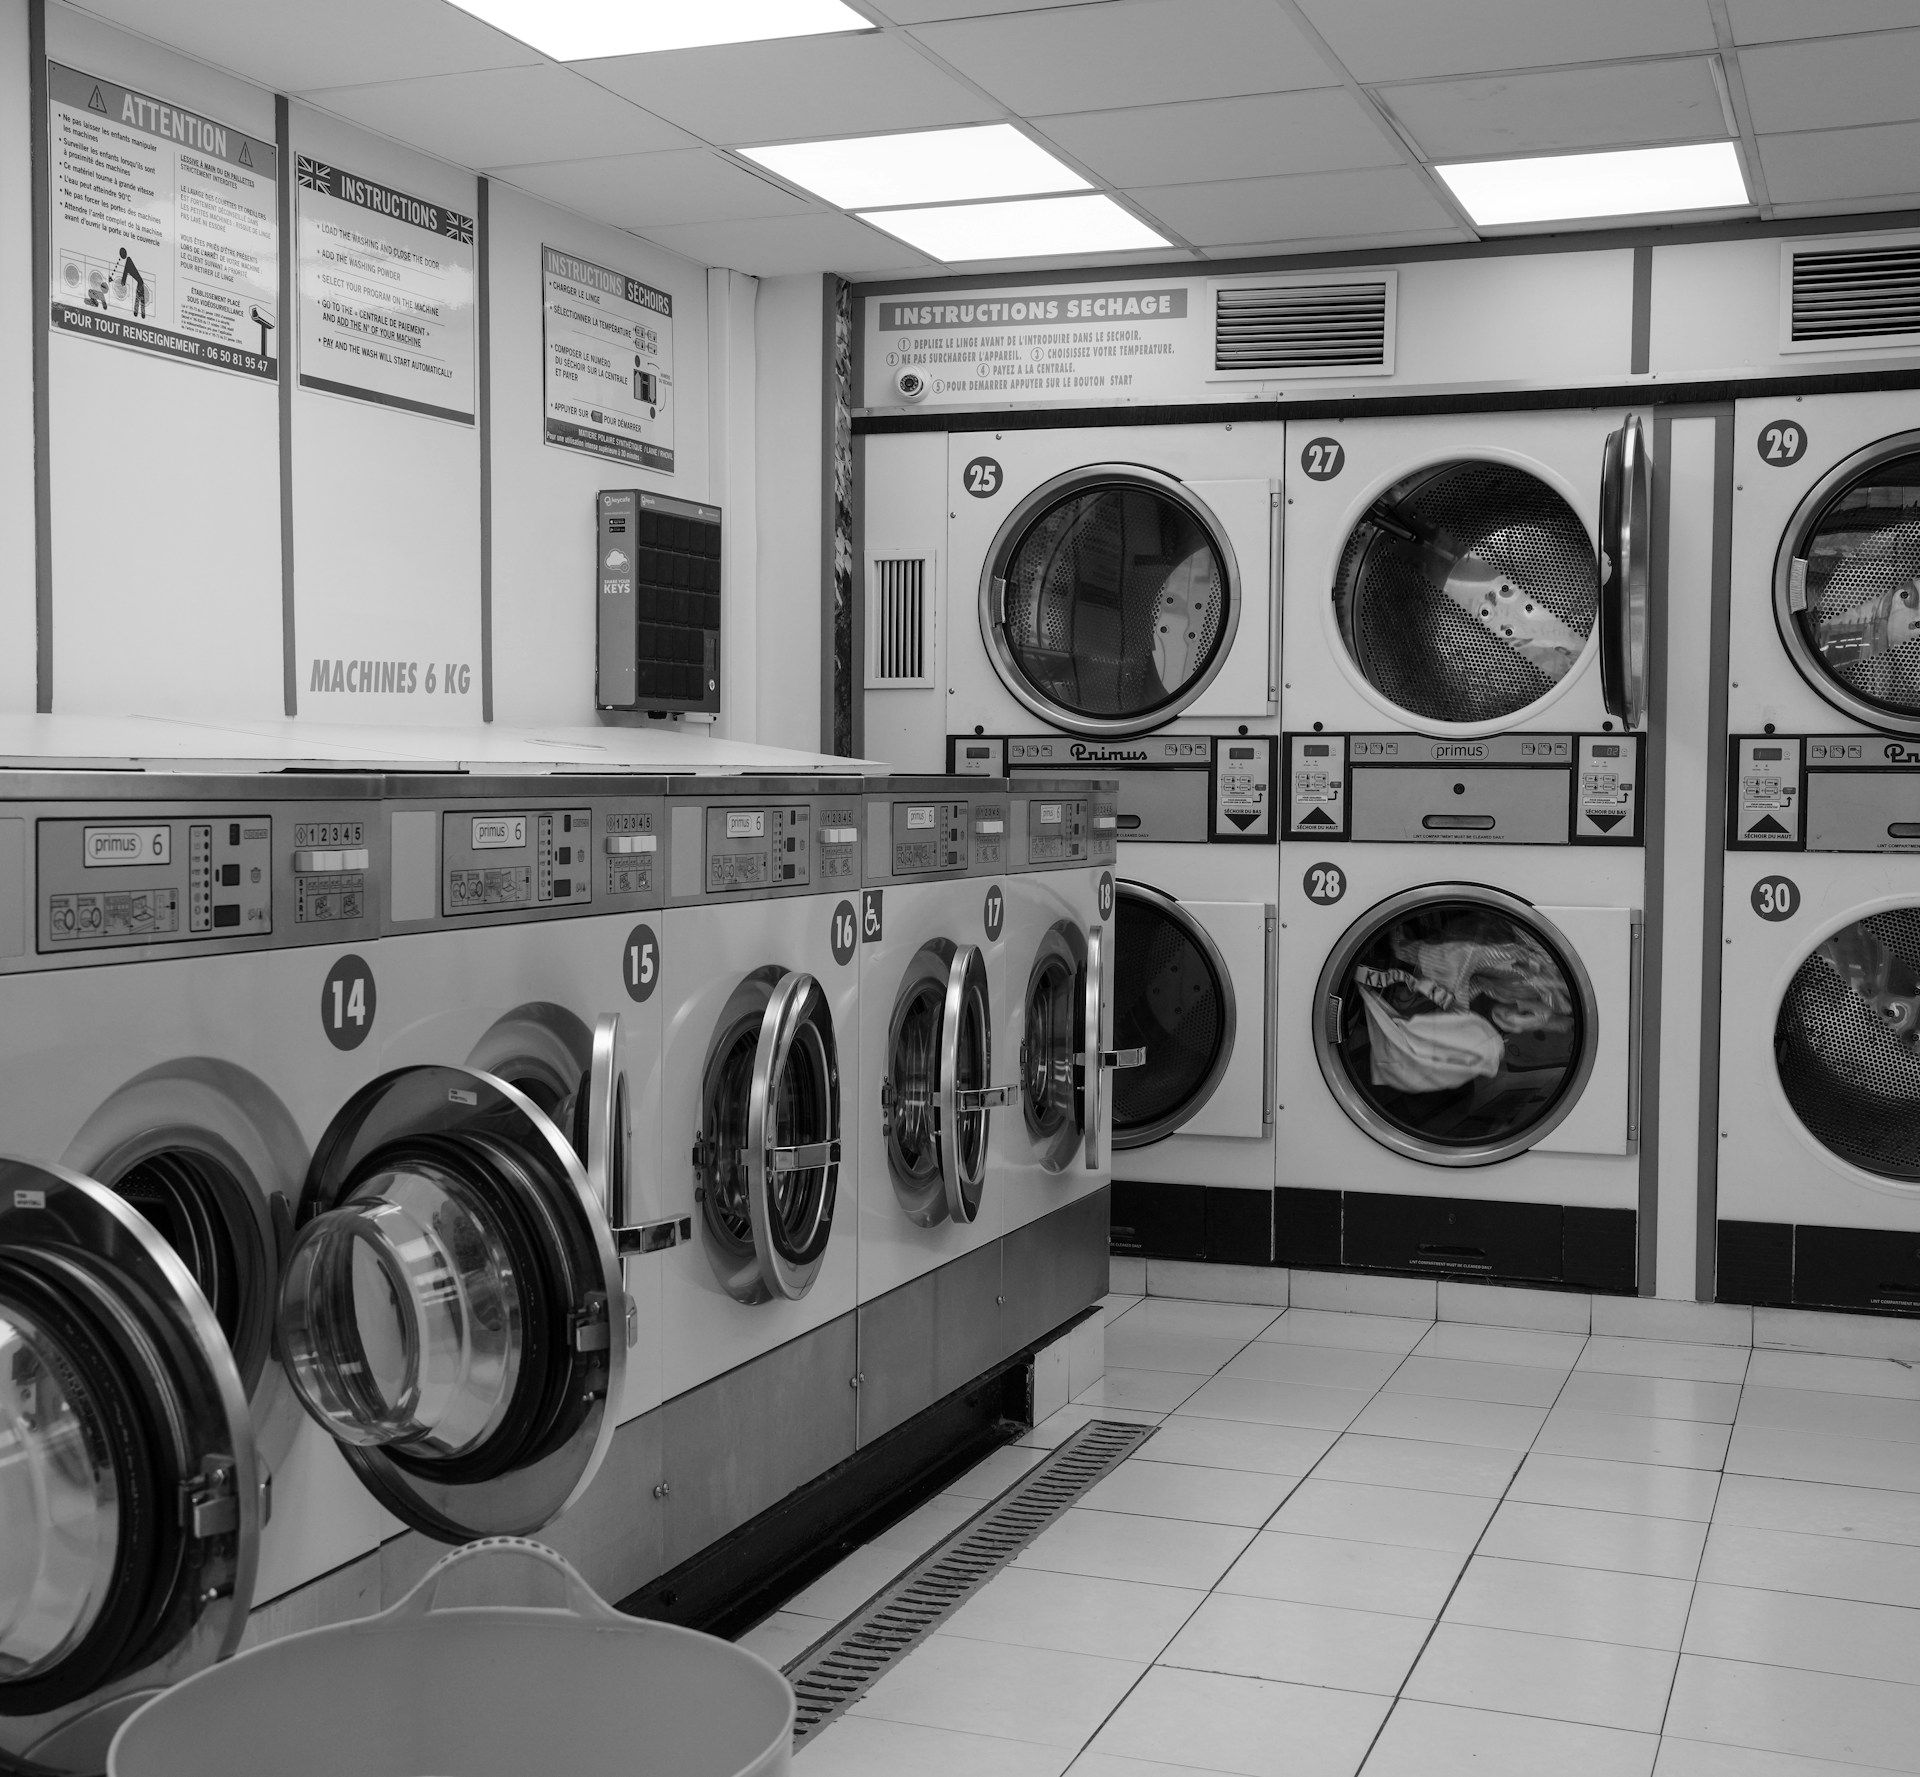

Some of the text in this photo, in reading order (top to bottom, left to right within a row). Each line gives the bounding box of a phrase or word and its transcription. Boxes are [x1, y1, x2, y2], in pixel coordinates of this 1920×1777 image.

[122, 93, 227, 158] ATTENTION
[342, 175, 437, 231] INSTRUCTIONS
[322, 224, 338, 238] LOAD
[339, 230, 351, 242] THE
[351, 233, 379, 251] WASHING
[380, 243, 392, 255] AND
[413, 254, 423, 265] THE
[425, 258, 440, 270] DOOR
[322, 249, 401, 281] ADD THE WASHING POWDER
[322, 274, 439, 317] SELECT YOUR PROGRAM ON THE MACHINE
[548, 251, 669, 315] INSTRUCTIONS SÉCHOIRS
[553, 280, 601, 305] CHARGER LE LINGE
[187, 295, 199, 305] SOUS
[894, 295, 1171, 327] INSTRUCTIONS SECHAGE
[322, 299, 331, 310] GO
[333, 302, 340, 312] TO
[342, 305, 353, 316] THE
[359, 310, 388, 326] CENTRALE
[390, 318, 397, 328] DE
[398, 321, 425, 336] PAIEMENT
[323, 312, 336, 324] AND
[337, 316, 349, 328] ADD
[350, 320, 362, 331] THE
[371, 325, 378, 336] OF
[380, 328, 395, 340] YOUR
[396, 332, 421, 347] MACHINE
[554, 303, 632, 339] SÉLECTIONNER LA TEMPÉRATURE
[64, 311, 91, 329] POUR
[95, 318, 120, 337] TOUT
[123, 325, 200, 357] RENSEIGNEMENT
[207, 346, 218, 361] 06
[220, 350, 231, 364] 50
[233, 353, 243, 367] 81
[245, 356, 256, 371] 95
[258, 359, 268, 374] 47
[914, 338, 943, 350] DEPLIEZ
[946, 338, 953, 349] LE
[956, 337, 978, 348] LINGE
[980, 336, 1004, 347] AVANT
[1007, 335, 1016, 346] DE
[1019, 333, 1070, 346] L'INTRODUIRE
[1073, 332, 1093, 344] DANS
[1096, 332, 1104, 342] LE
[1048, 347, 1091, 360] CHOISISSEZ
[1093, 346, 1117, 357] VOTRE
[323, 337, 453, 379] PAY AND THE WASH WILL START AUTOMATICALLY
[902, 354, 911, 364] NE
[913, 354, 927, 364] PAS
[929, 351, 976, 364] SURCHARGER
[993, 364, 1015, 376] PAYEZ
[1018, 365, 1022, 375] A
[1025, 364, 1034, 374] LA
[946, 374, 1132, 393] POUR DEMARRER APPUYER SUR LE BOUTON START
[1766, 428, 1799, 458] 29
[1308, 445, 1339, 472] 27
[970, 465, 995, 491] 25
[604, 584, 630, 594] KEYS
[310, 660, 470, 694] MACHINES 6 KG
[1070, 744, 1147, 760] Primus
[1436, 744, 1483, 759] primus
[928, 810, 933, 823] 6
[95, 833, 162, 855] primus 6
[479, 823, 522, 840] primus 6
[1100, 883, 1111, 910] 18
[1312, 870, 1339, 897] 28
[988, 897, 1002, 927] 17
[1760, 884, 1790, 913] 30
[836, 914, 853, 949] 16
[630, 943, 654, 985] 15
[332, 978, 366, 1029] 14
